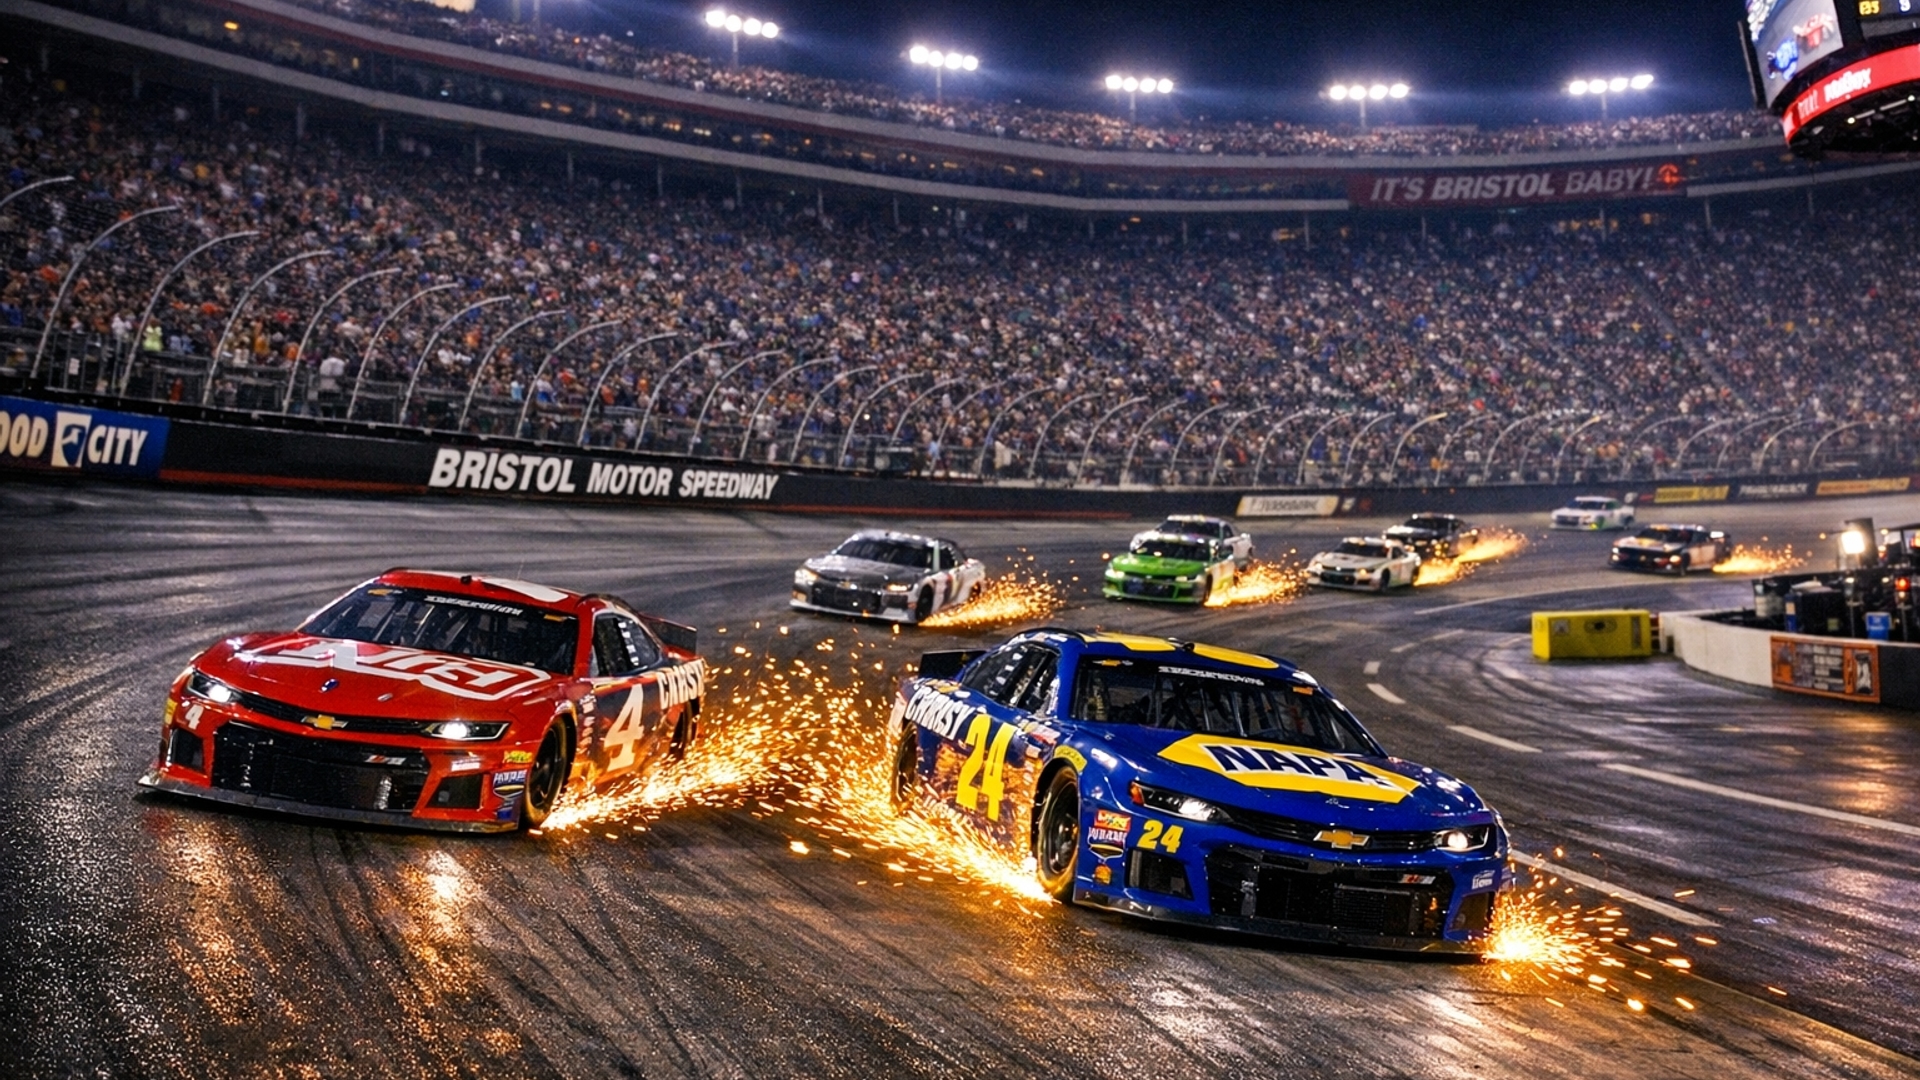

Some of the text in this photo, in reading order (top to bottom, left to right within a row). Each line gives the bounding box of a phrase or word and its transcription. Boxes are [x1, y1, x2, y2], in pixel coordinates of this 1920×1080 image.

[1370, 167, 1653, 202] IT'S BRISTOL BABY!
[87, 425, 148, 466] CITY
[429, 448, 779, 499] BRISTOL MOTOR SPEEDWAY
[185, 704, 204, 730] 4
[604, 684, 644, 772] 4
[956, 713, 1018, 822] 24
[1202, 744, 1392, 789] NAPA
[1137, 819, 1183, 853] 24
